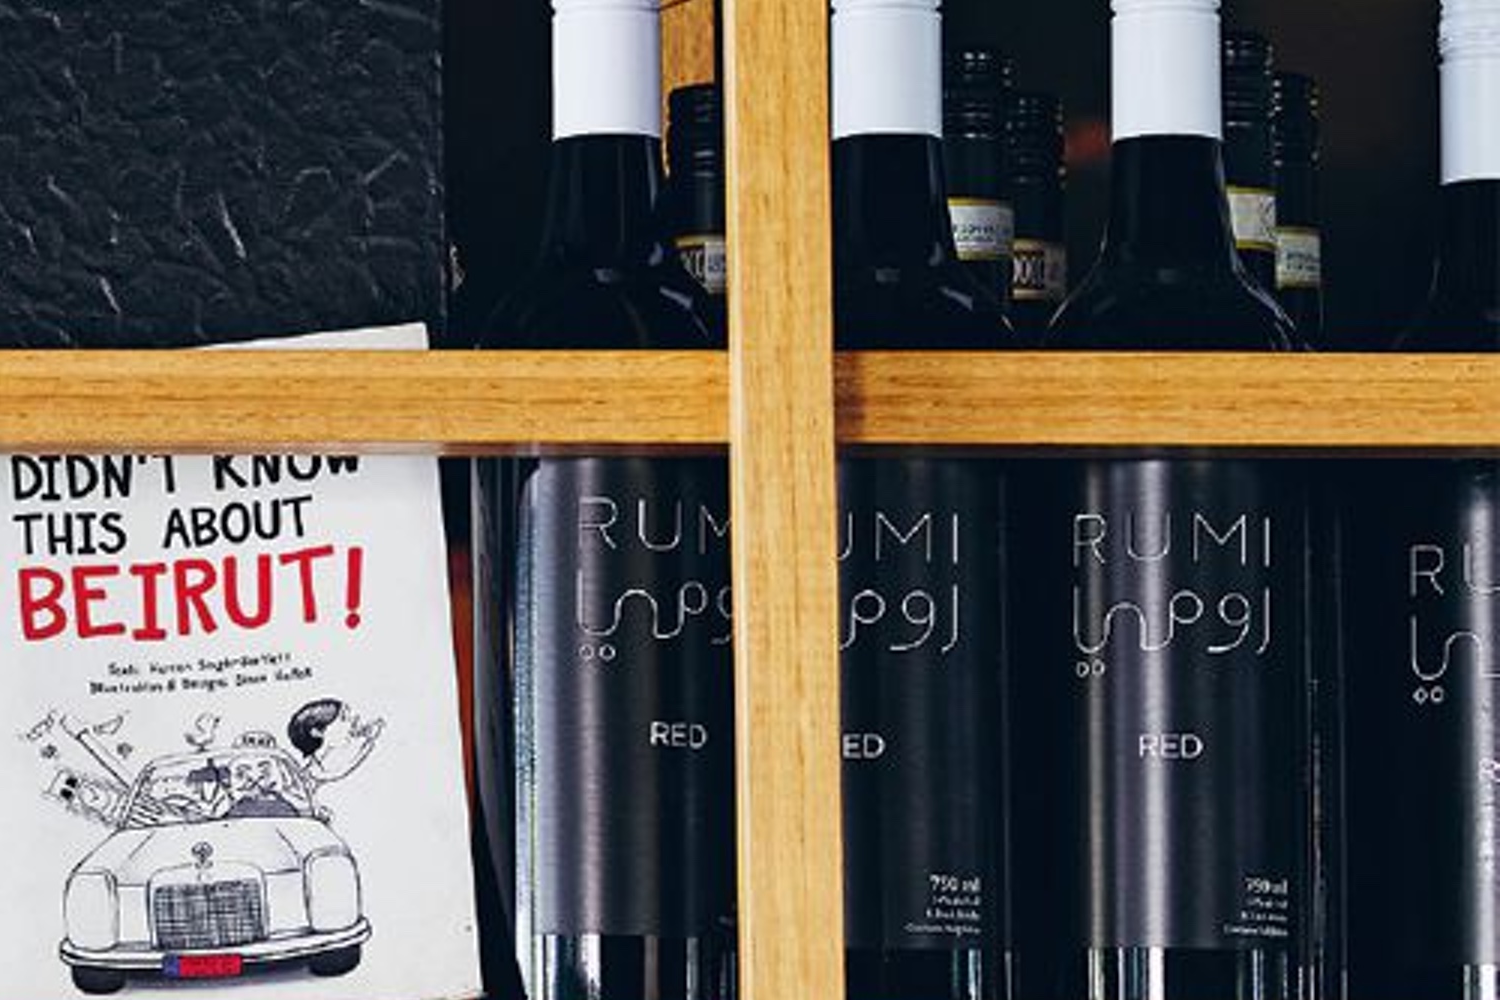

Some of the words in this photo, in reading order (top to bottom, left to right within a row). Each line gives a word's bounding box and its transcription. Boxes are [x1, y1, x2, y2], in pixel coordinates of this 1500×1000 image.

[11, 454, 175, 500] DIDN'T
[12, 511, 128, 556] THIS
[162, 494, 313, 550] ABOUT
[578, 496, 733, 554] RUM
[838, 511, 959, 564] MI
[1073, 512, 1271, 567] RUMI
[17, 544, 364, 641] BEIRUT!
[1410, 543, 1500, 597] RU
[650, 720, 708, 749] RED
[841, 733, 886, 759] ED
[1138, 733, 1204, 760] RED
